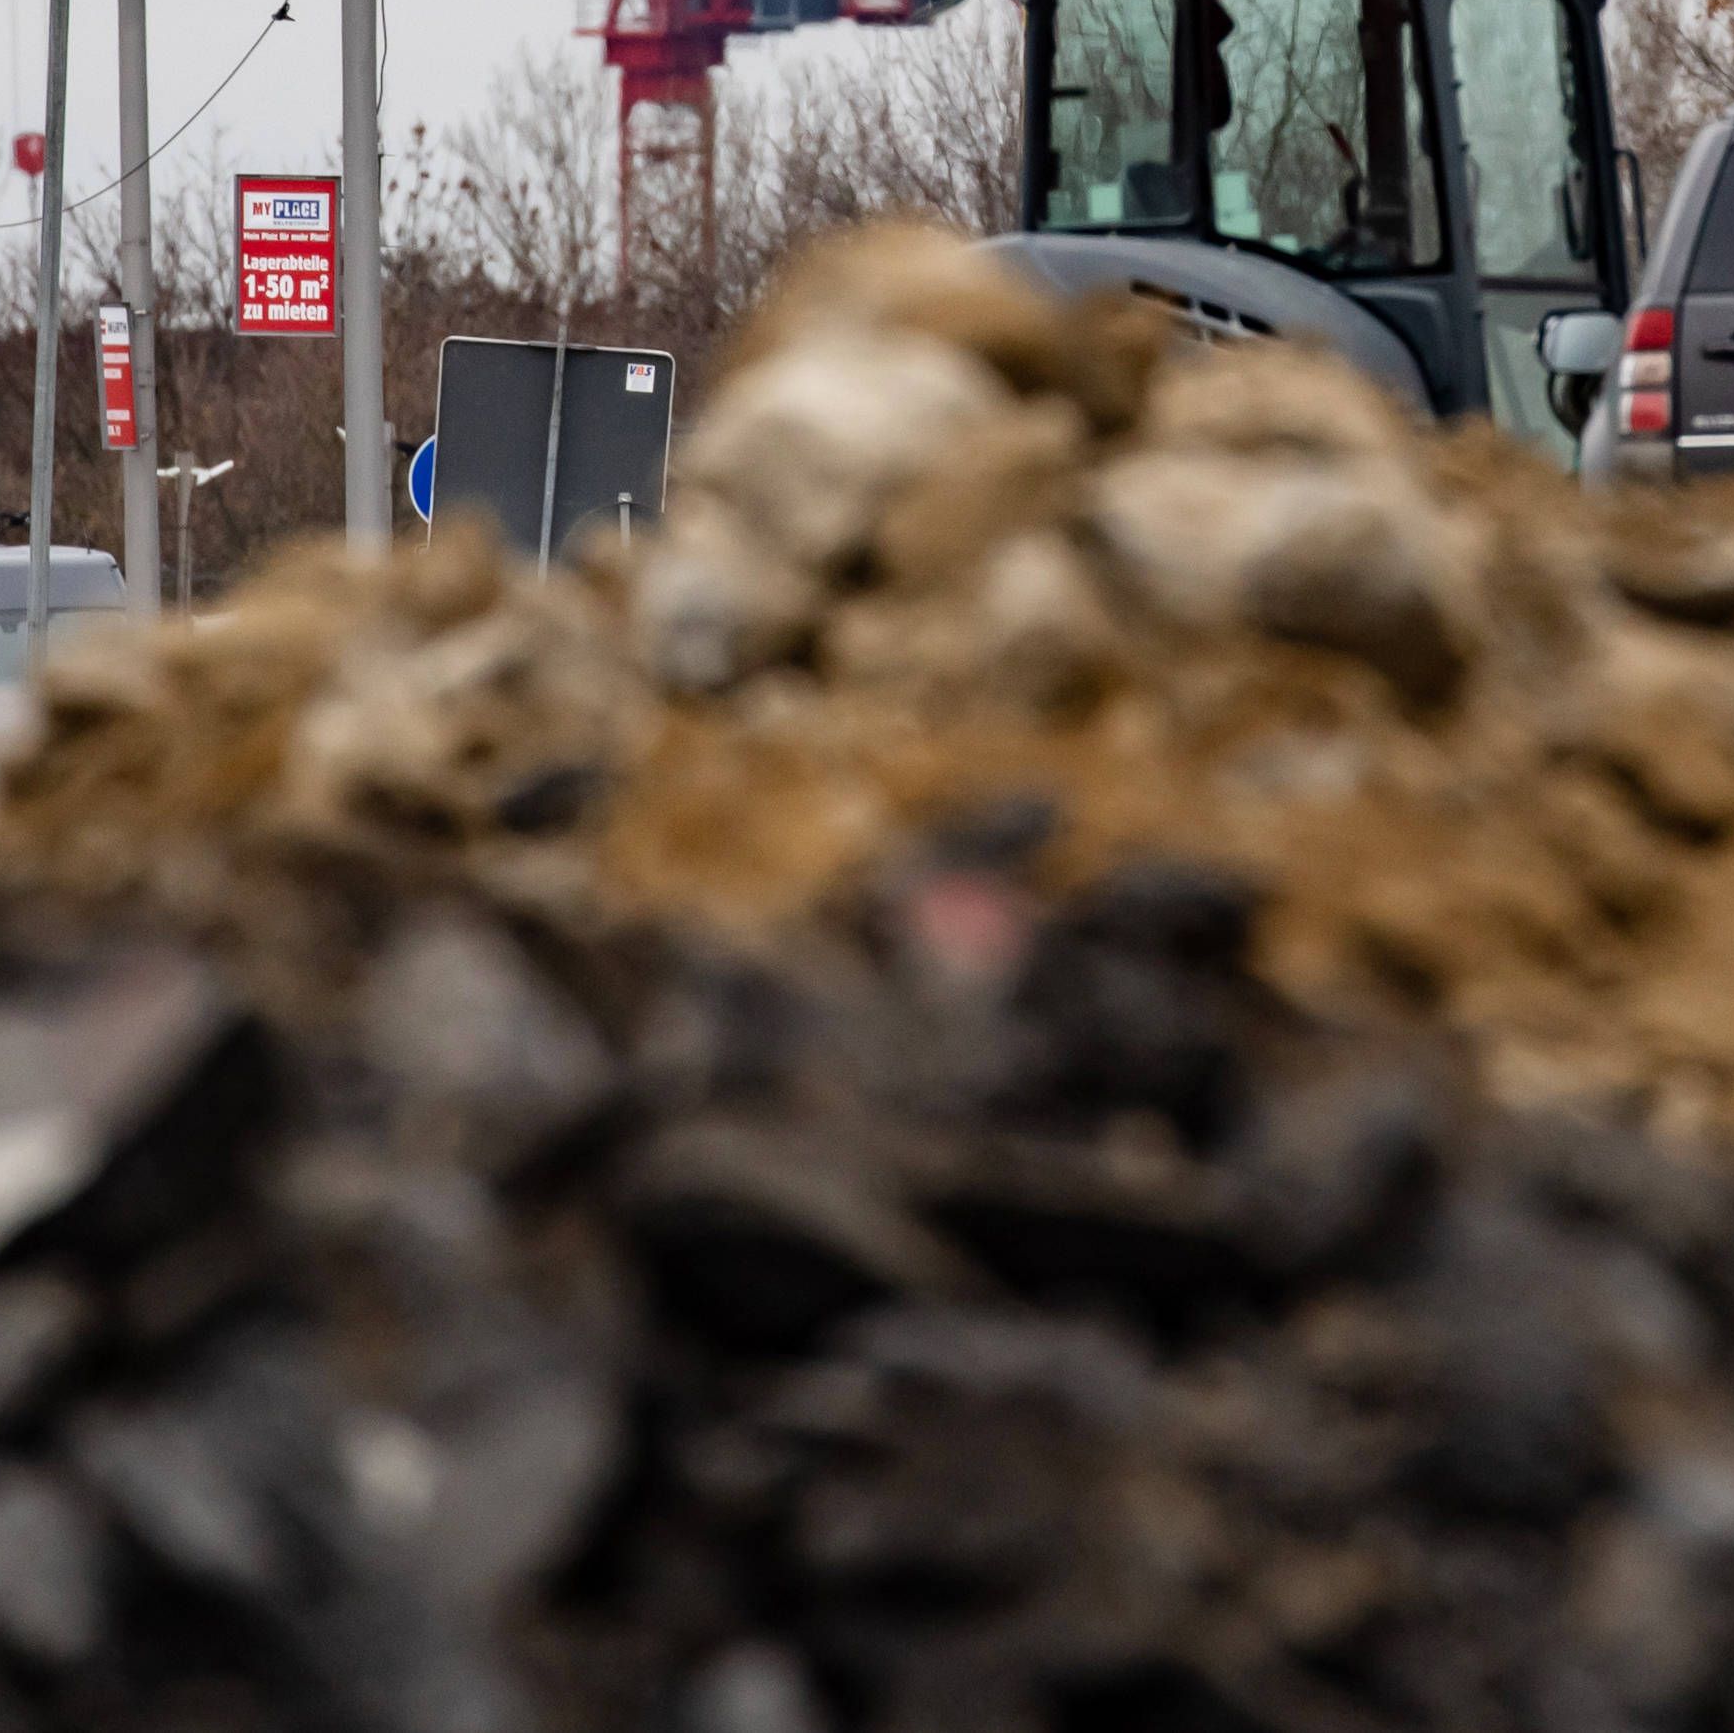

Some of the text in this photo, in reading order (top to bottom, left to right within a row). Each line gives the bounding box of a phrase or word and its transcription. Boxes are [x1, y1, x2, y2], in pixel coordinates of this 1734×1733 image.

[252, 201, 318, 217] MY PLACE
[243, 253, 329, 272] Lagerabteile
[244, 274, 294, 299] 1-50
[243, 301, 328, 321] zu mieten
